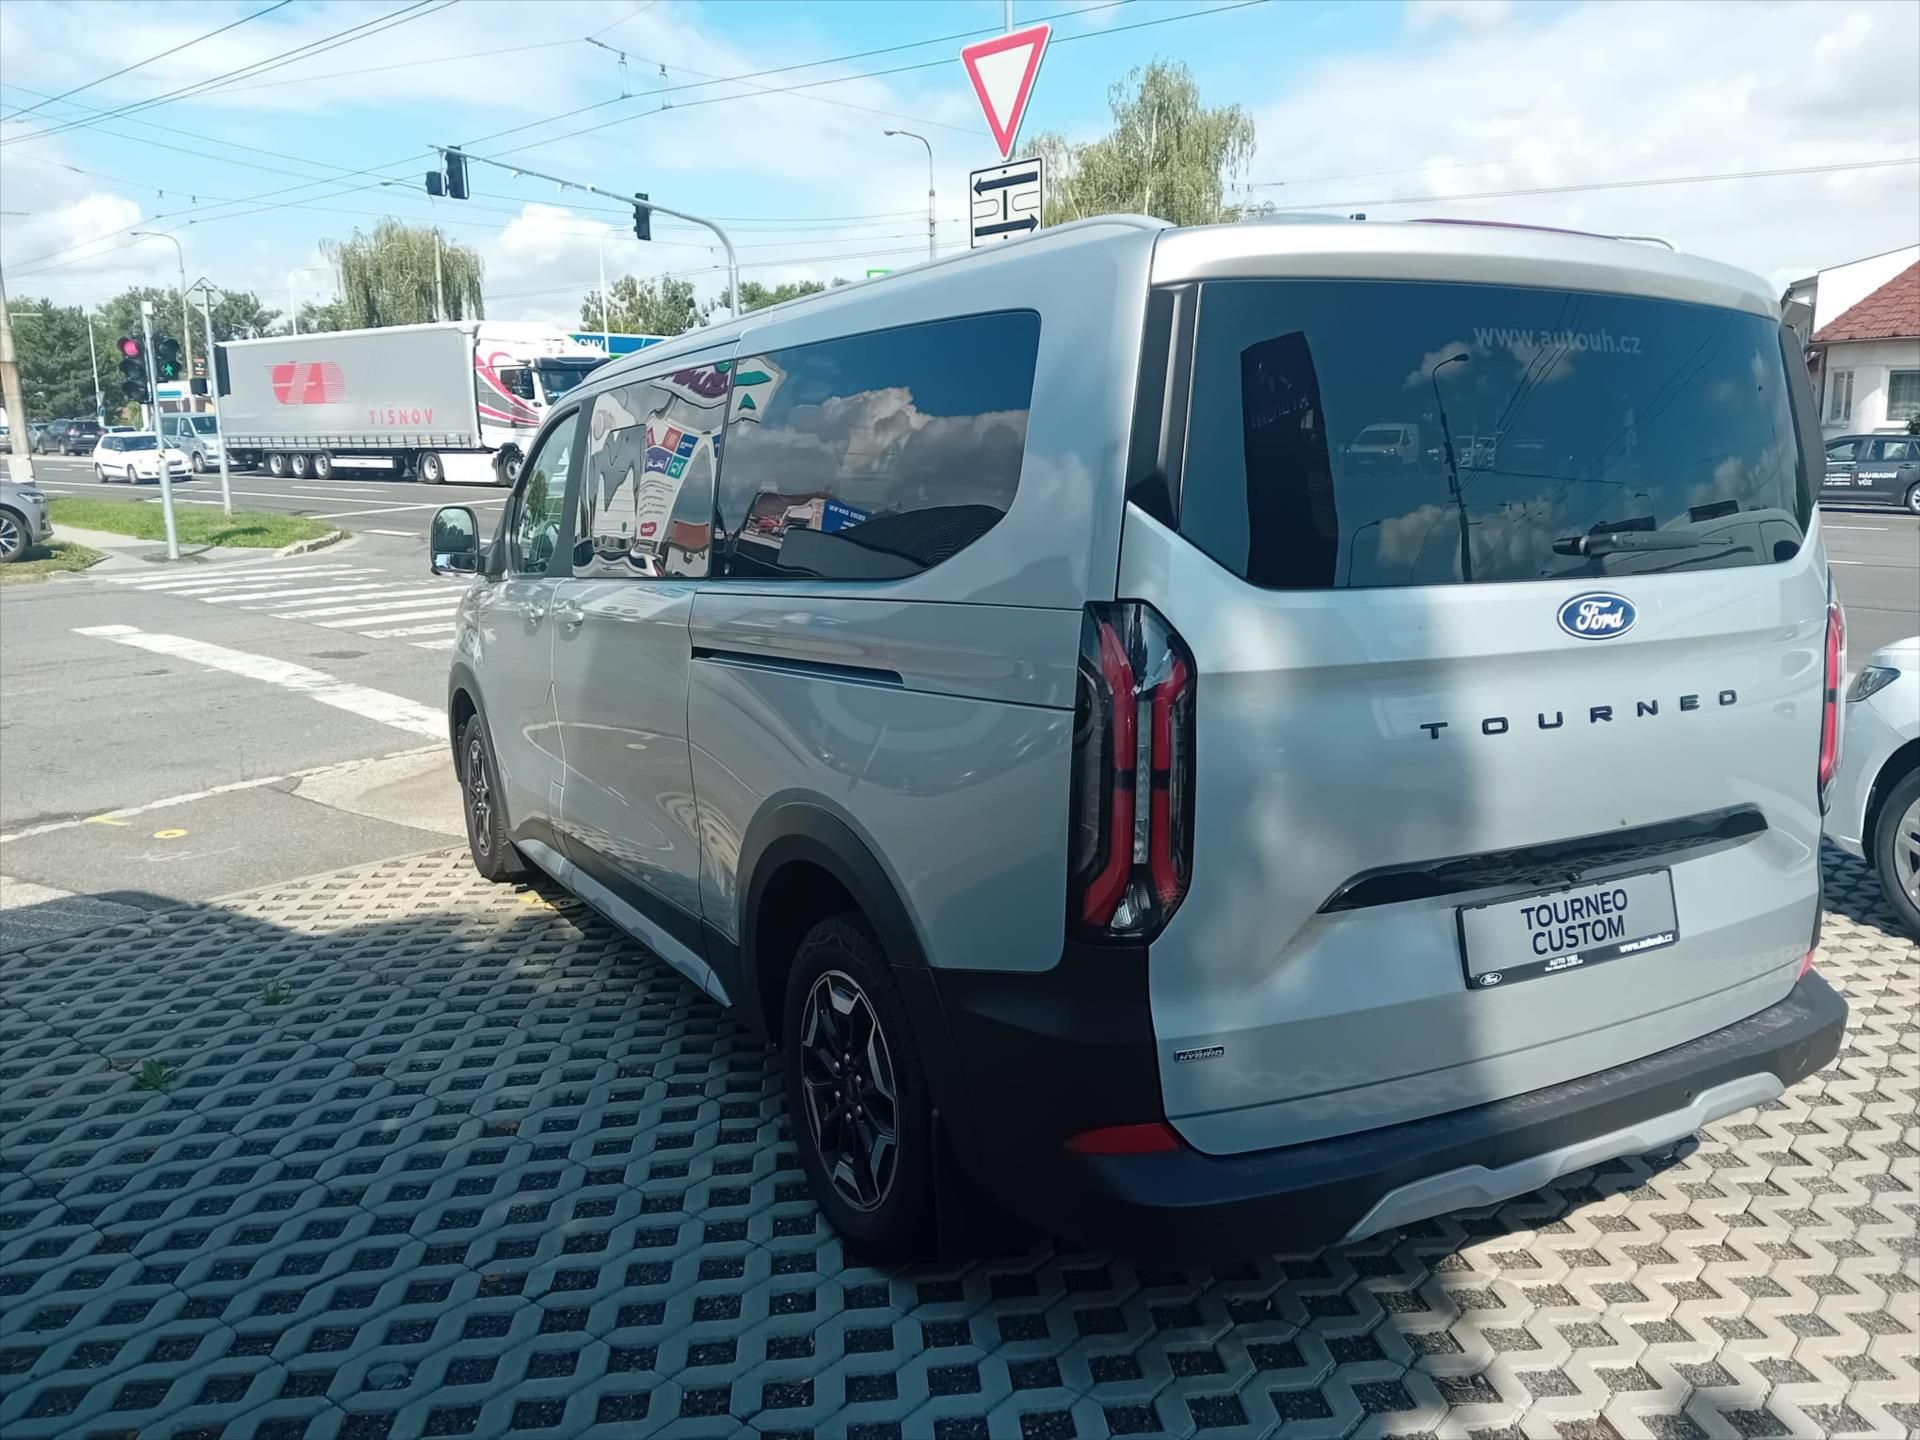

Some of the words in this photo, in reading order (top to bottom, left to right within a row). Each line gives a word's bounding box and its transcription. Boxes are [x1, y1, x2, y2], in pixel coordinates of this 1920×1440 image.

[1473, 328, 1641, 353] www.autouh.cz
[1576, 601, 1624, 630] Ford
[1420, 689, 1738, 739] TOURNEO
[1520, 888, 1628, 930] TOURNEO
[1532, 914, 1626, 955] CUSTOM
